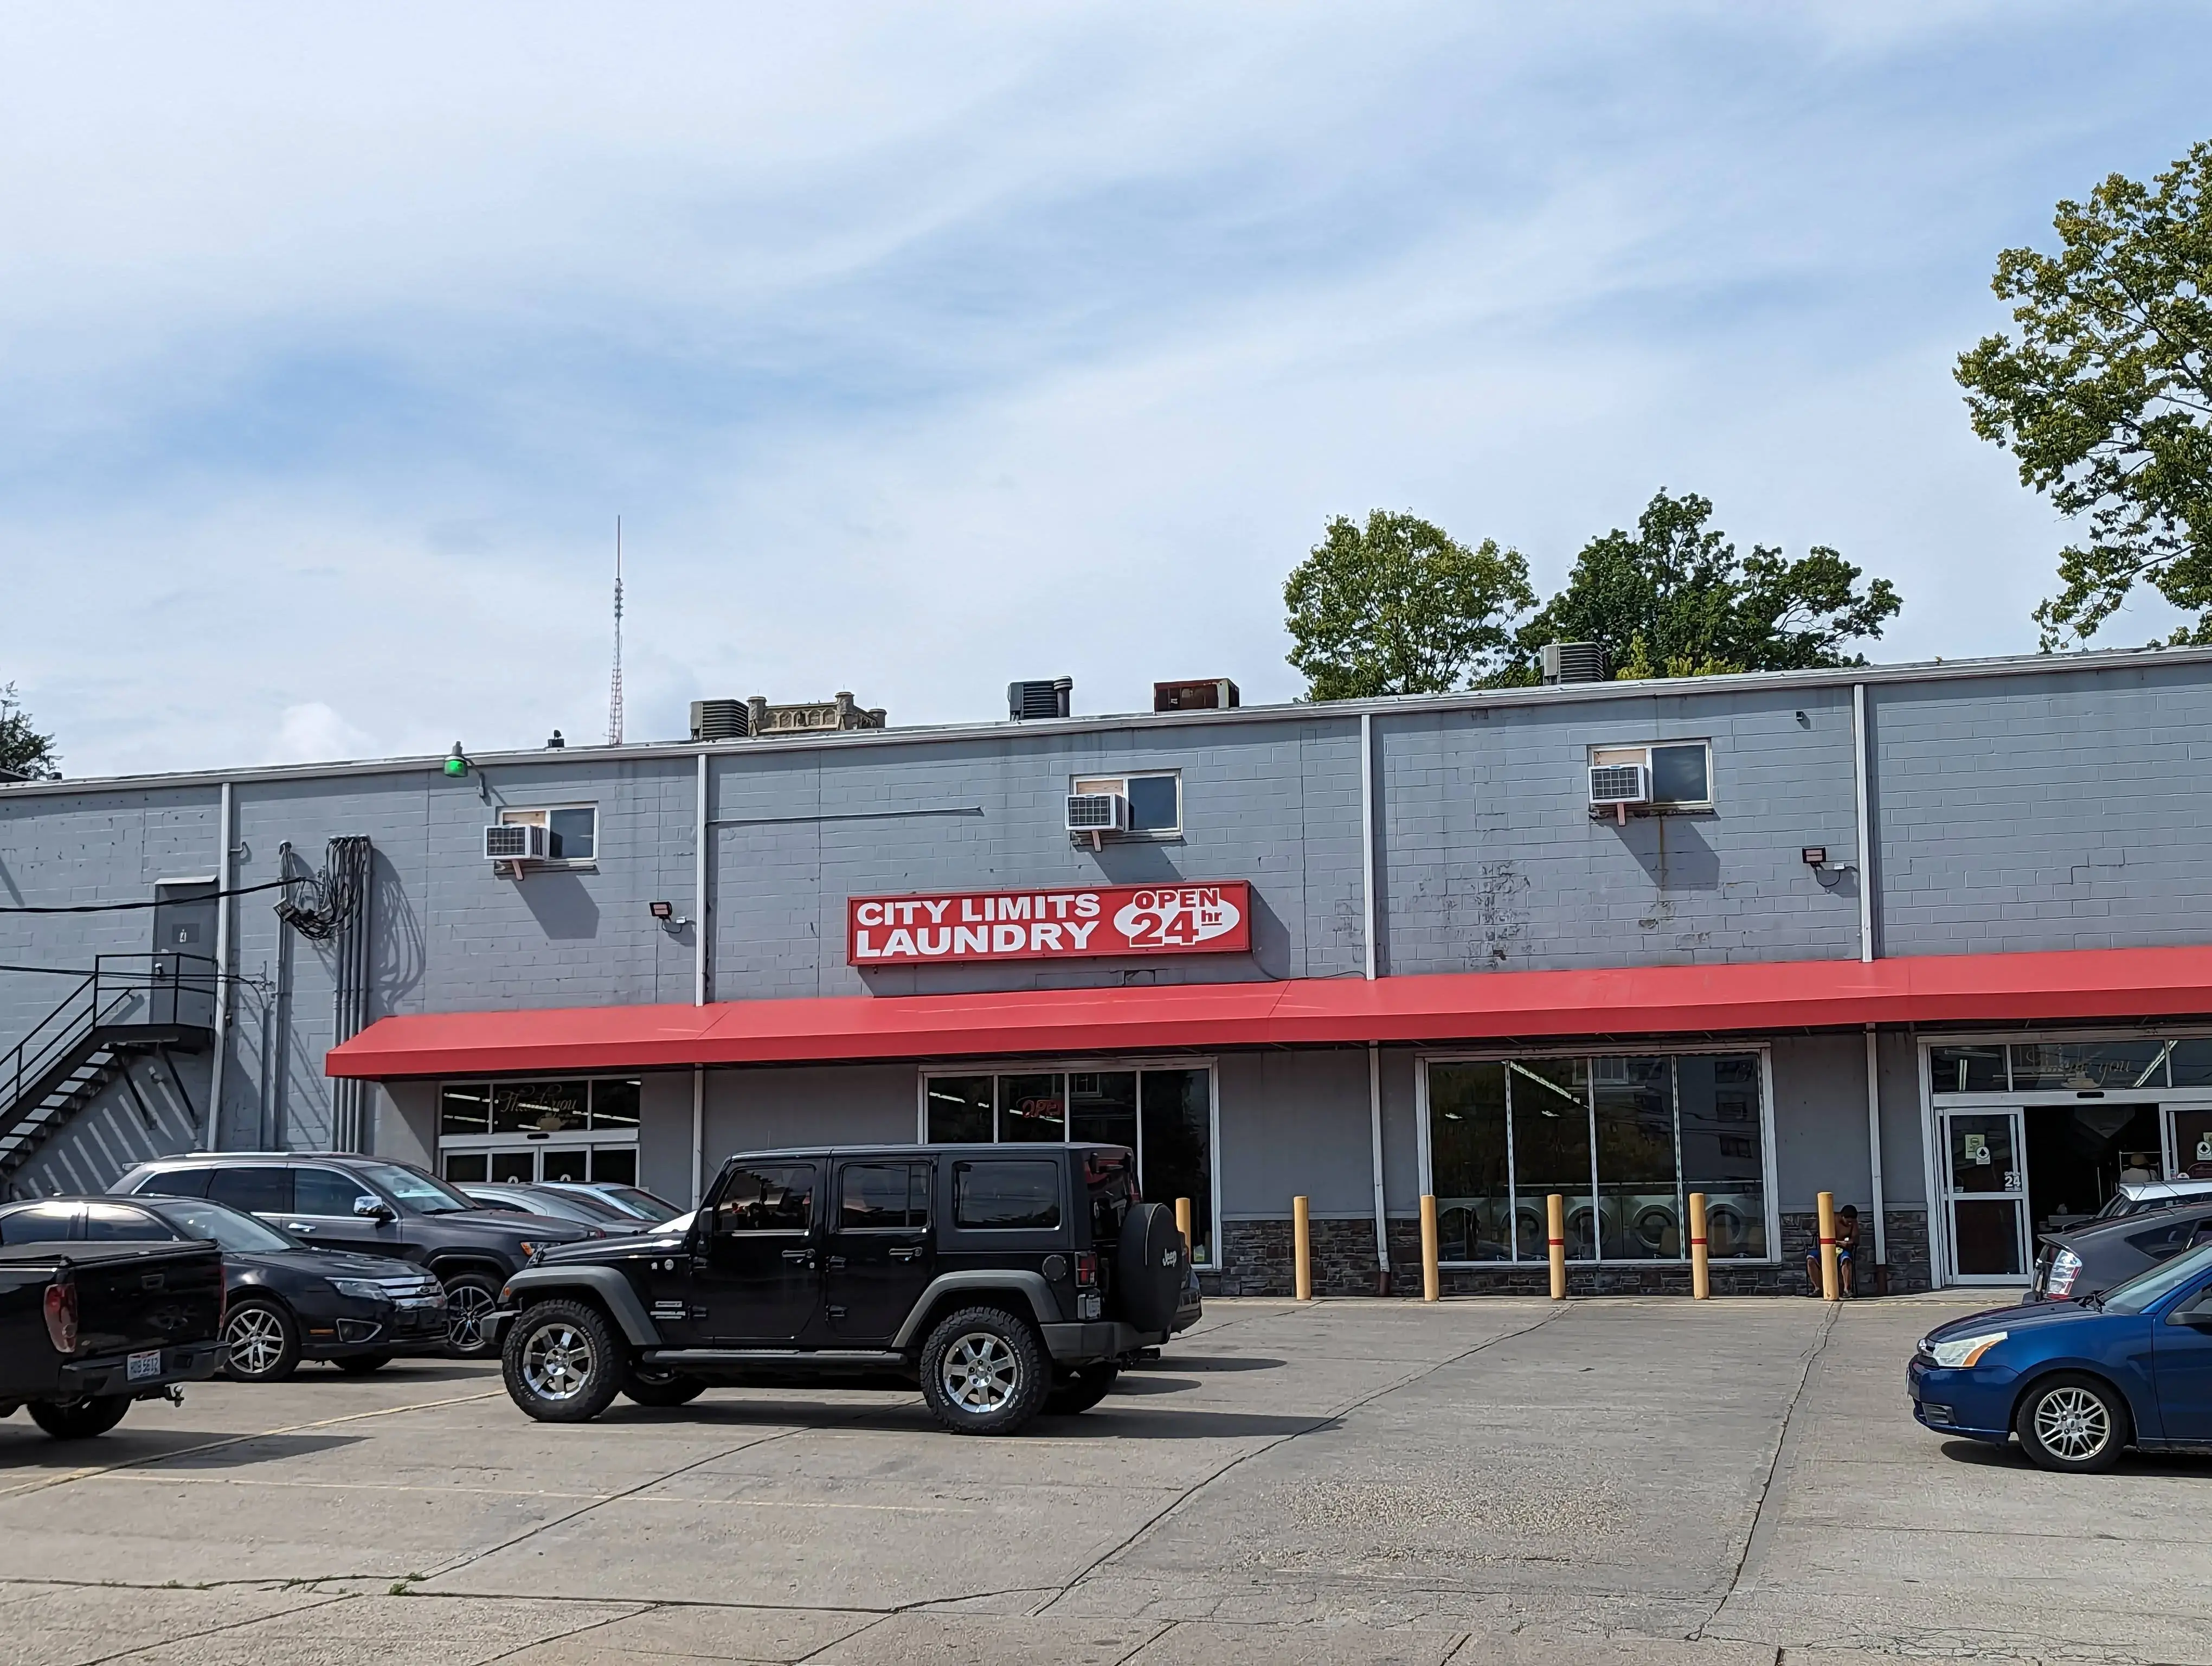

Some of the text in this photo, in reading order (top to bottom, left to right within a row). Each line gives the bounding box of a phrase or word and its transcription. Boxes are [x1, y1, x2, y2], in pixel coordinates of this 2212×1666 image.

[857, 894, 1100, 926] CITY LIMITS
[1133, 888, 1220, 910] OPEN
[857, 921, 1100, 957] LAUNDRY
[1129, 909, 1223, 947] 24 hr
[2005, 1176, 2021, 1187] 24
[1162, 1248, 1177, 1267] Jeep
